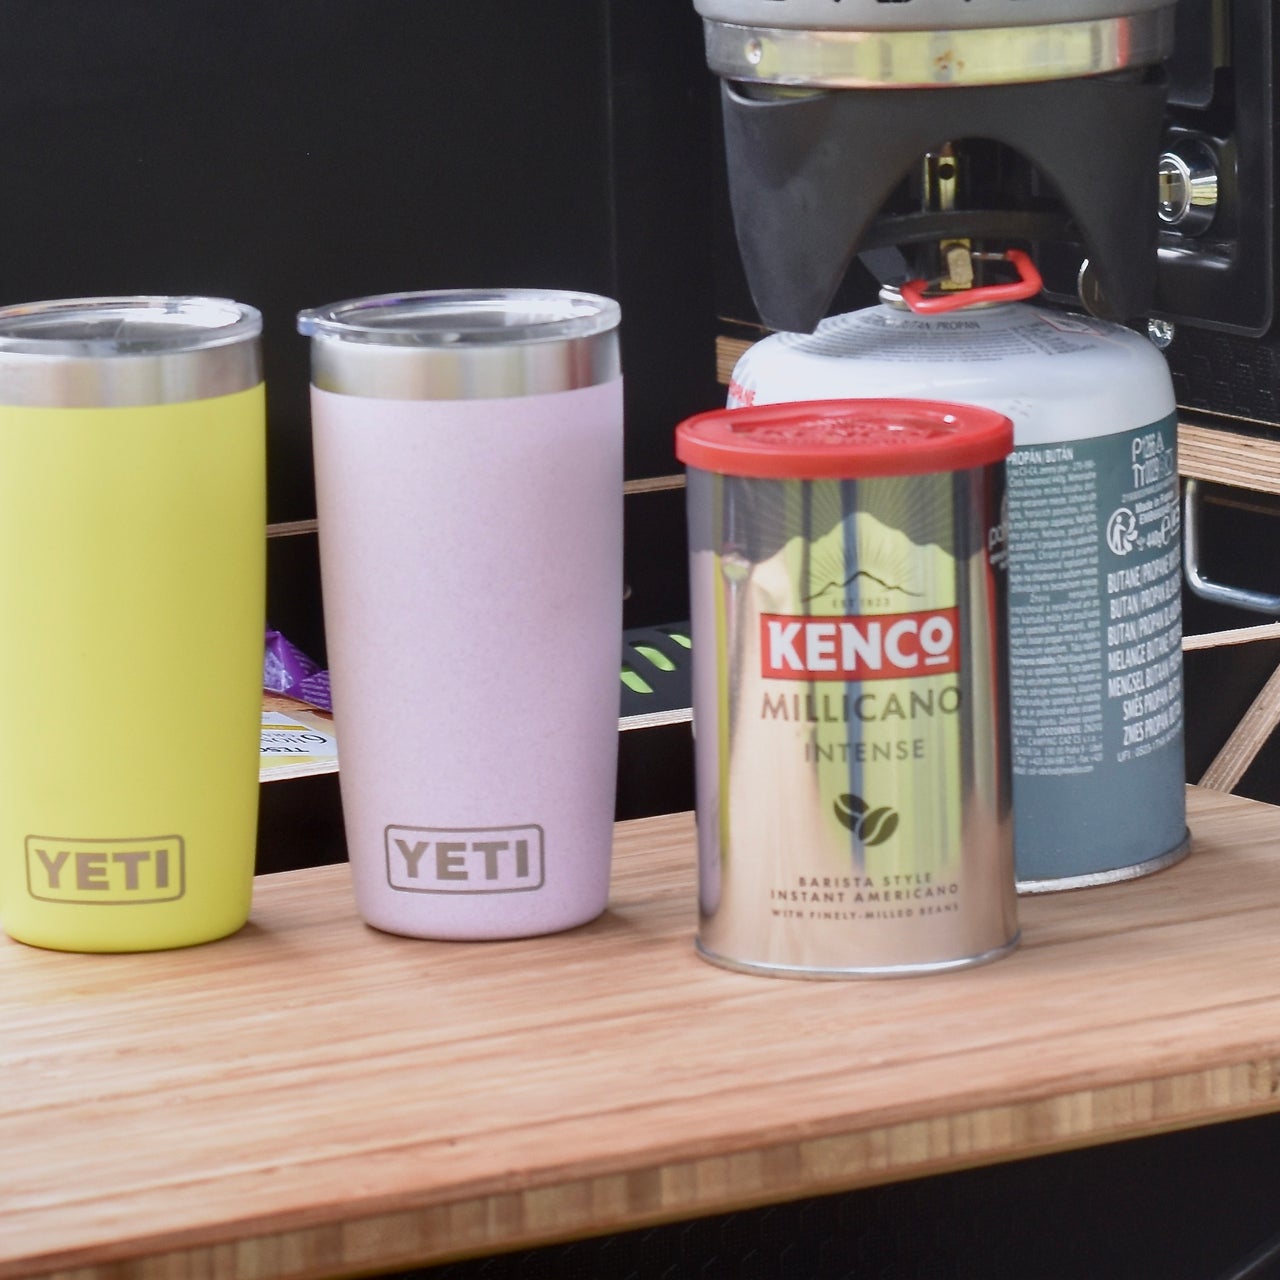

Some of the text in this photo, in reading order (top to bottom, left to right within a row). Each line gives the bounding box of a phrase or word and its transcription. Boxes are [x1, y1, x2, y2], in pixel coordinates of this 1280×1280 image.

[767, 615, 954, 672] KENCO
[760, 685, 962, 723] MILLICANO
[805, 739, 925, 763] INTENSE
[33, 848, 170, 893] YETI
[393, 838, 531, 883] YETI
[770, 882, 959, 904] INSTANT AMERICANO
[798, 872, 932, 888] BARISTA STYLE
[771, 903, 959, 920] WITH FINELY-MILLED BEANS
